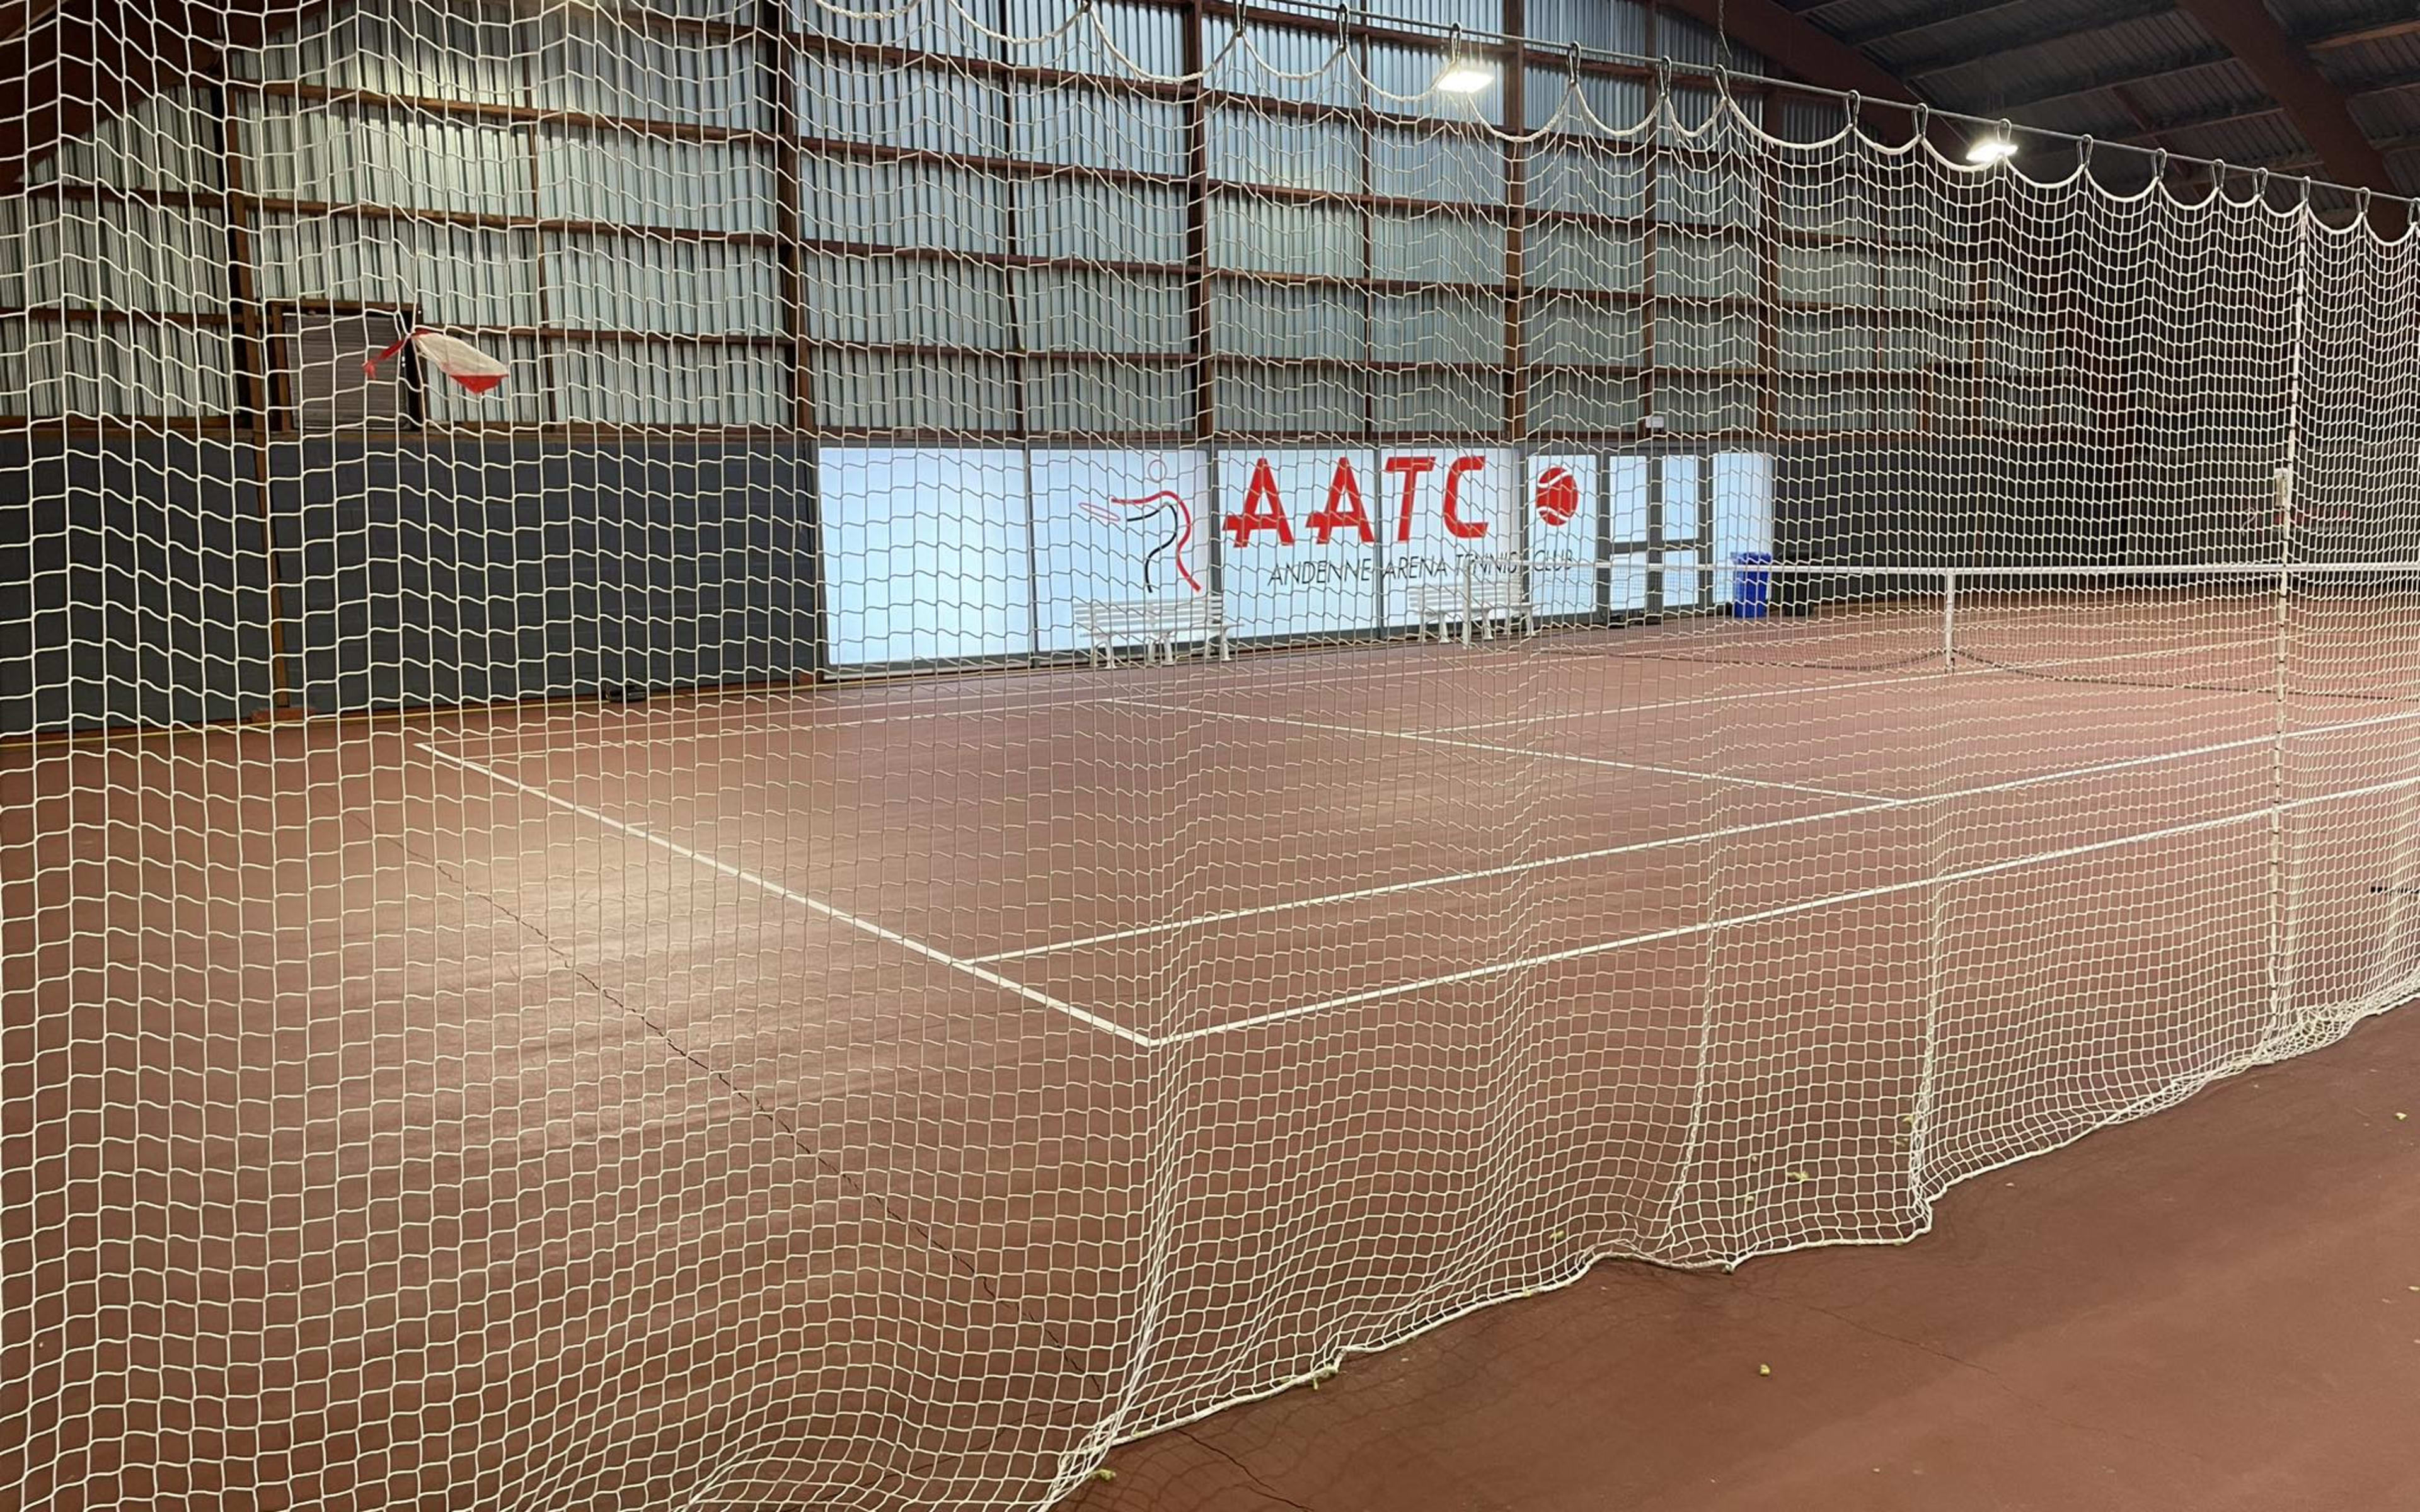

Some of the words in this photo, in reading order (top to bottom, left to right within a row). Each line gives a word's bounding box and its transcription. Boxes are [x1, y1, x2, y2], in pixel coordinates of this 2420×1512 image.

[1222, 455, 1489, 548] AATC
[1267, 558, 1371, 587] ANDENNE
[1381, 556, 1448, 580] ARENA
[1534, 549, 1574, 571] CLUB
